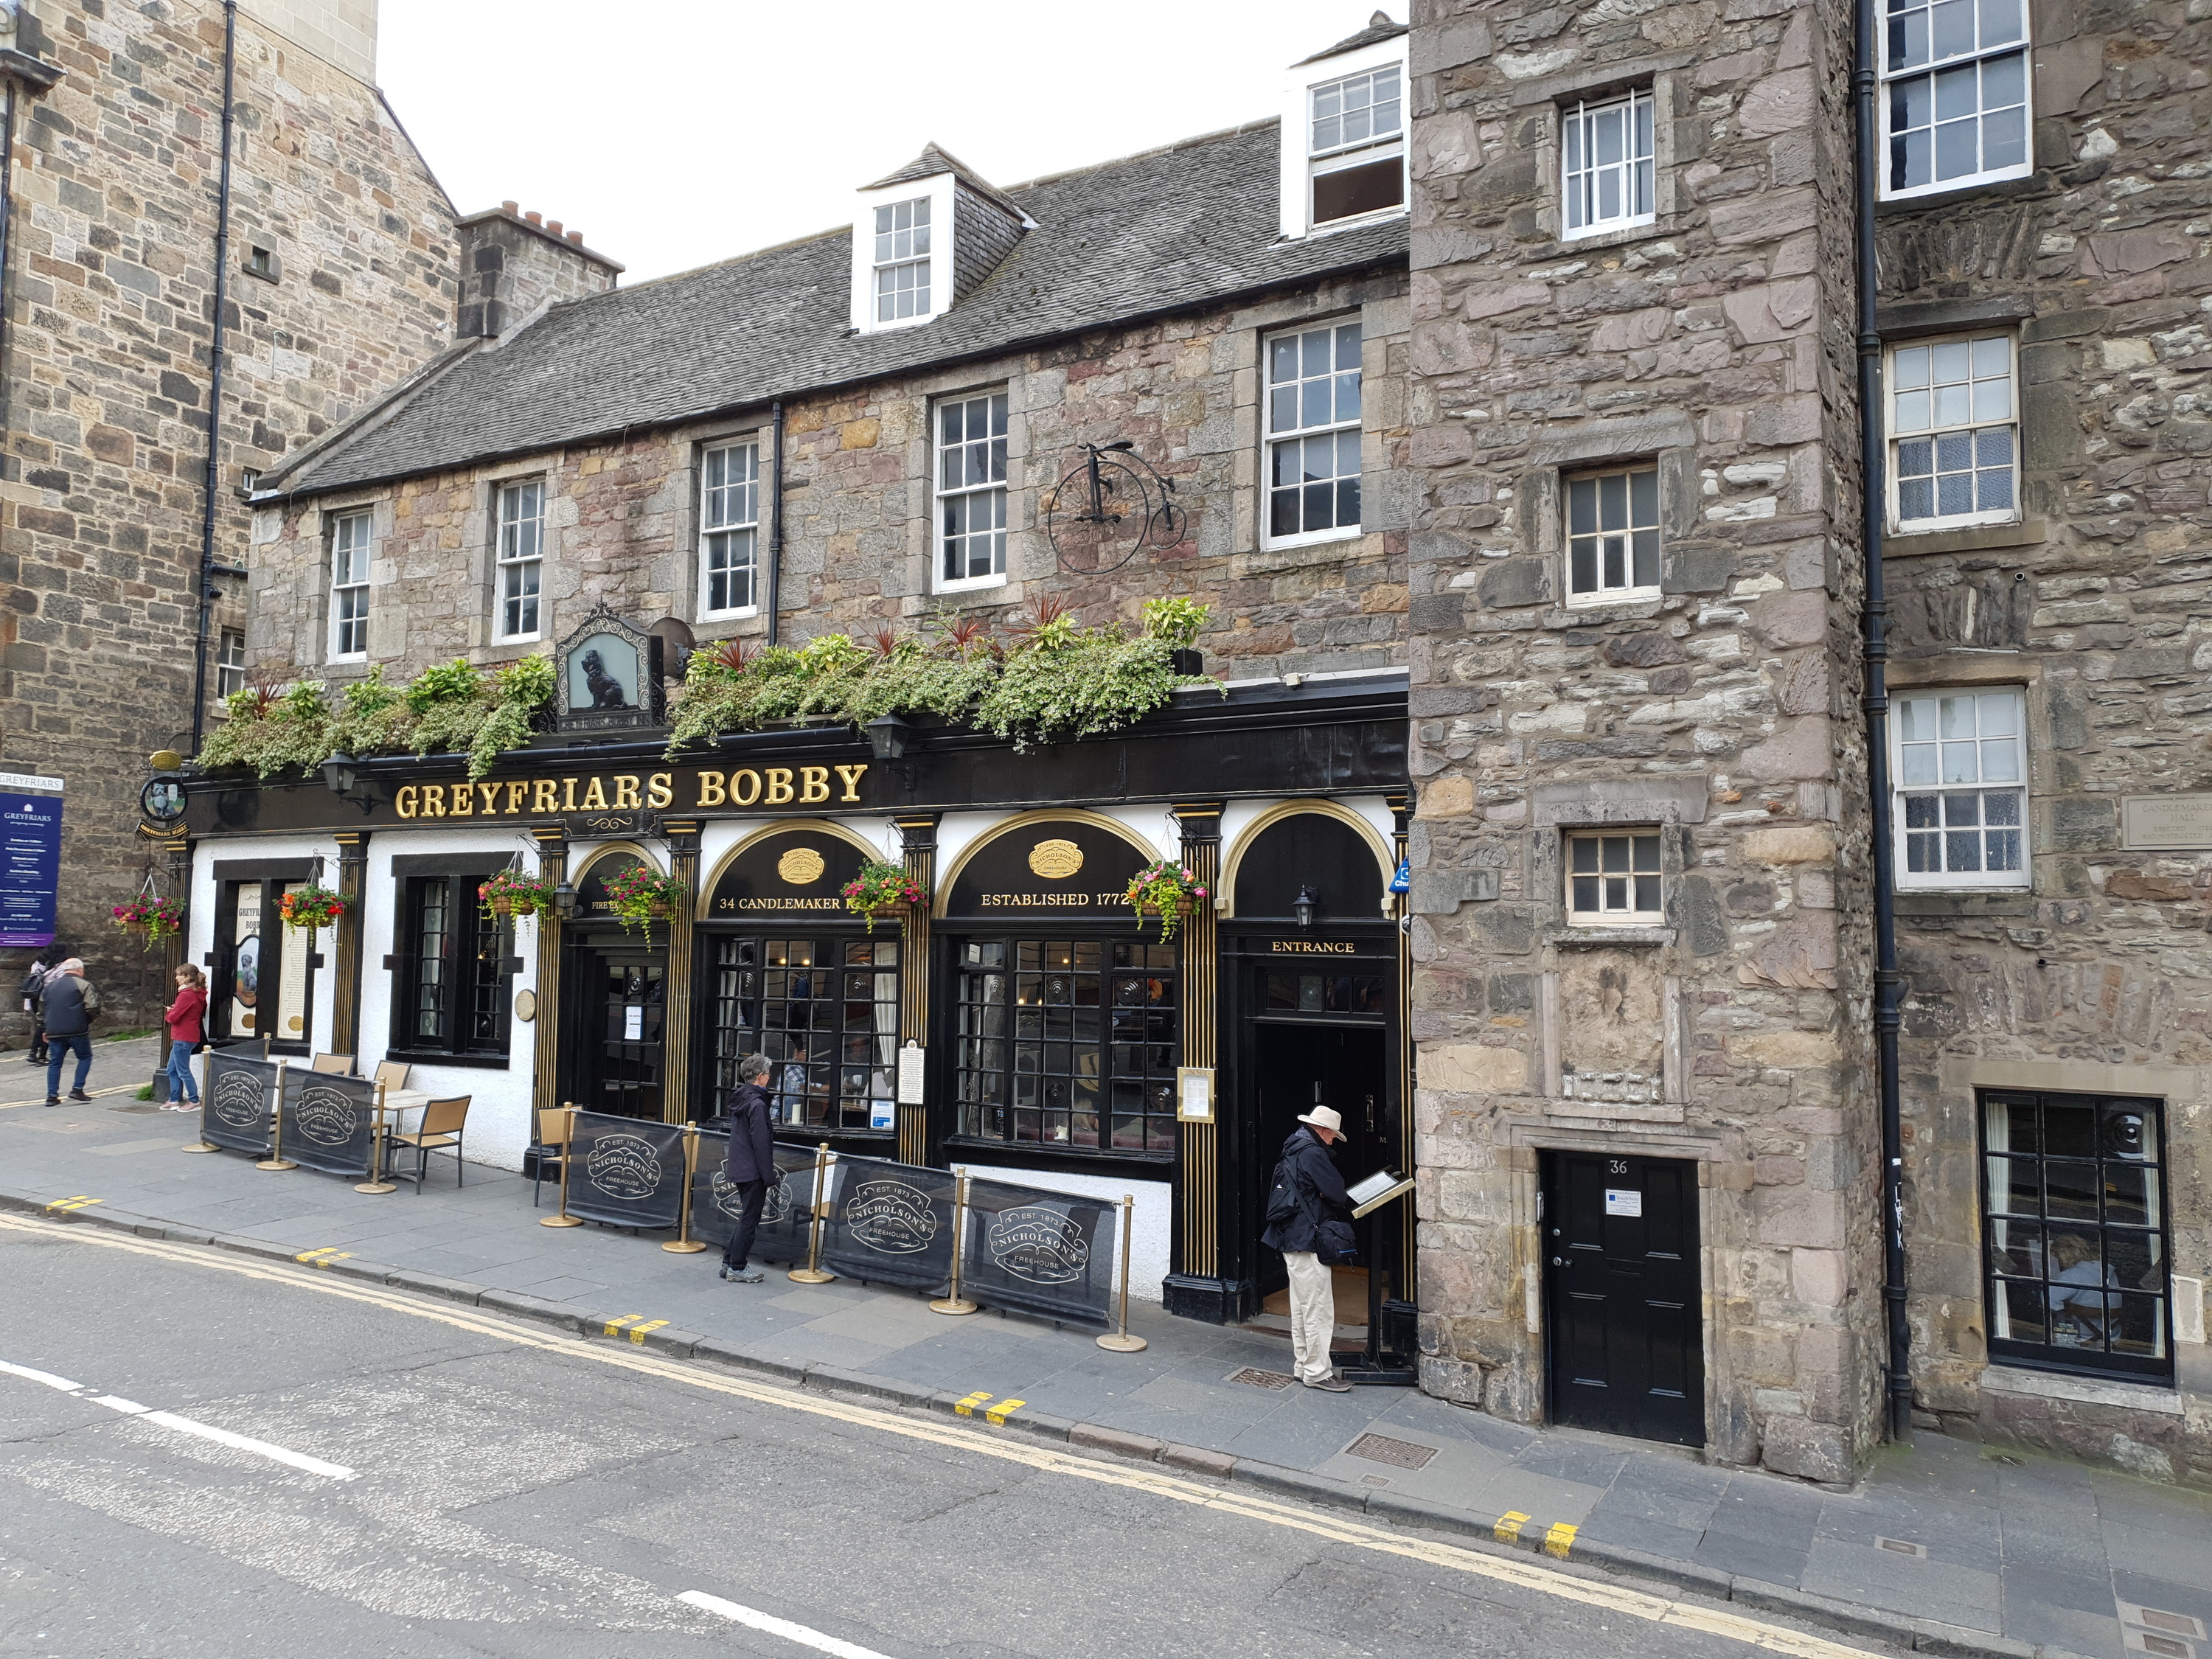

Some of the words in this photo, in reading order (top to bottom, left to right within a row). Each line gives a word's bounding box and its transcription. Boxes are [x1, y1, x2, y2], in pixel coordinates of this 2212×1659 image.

[0, 775, 59, 788] GREYFRIARS
[395, 773, 673, 818] GREYFRIARS
[697, 765, 868, 806] BOBBY
[4, 812, 52, 822] GREYFRIARS
[2171, 813, 2197, 821] HALL
[1035, 853, 1076, 865] NICHOLSON'S
[784, 860, 818, 871] NICHOLSON'S
[720, 898, 735, 909] 34
[739, 898, 841, 909] CANDLEMAKER
[981, 894, 1089, 905] ESTABLISHED
[1096, 893, 1130, 905] 1772
[591, 901, 608, 910] FIRE
[239, 908, 260, 917] GREYFR
[1272, 942, 1355, 953] ENTRANCE
[219, 1090, 258, 1109] NICHOLSON'S
[327, 1093, 338, 1102] 1873
[301, 1107, 349, 1128] NICHOLSON'S
[310, 1124, 338, 1134] FREEHOUSE
[627, 1141, 640, 1150] 1873
[594, 1157, 653, 1180] NICHOLSON'S
[1610, 1160, 1627, 1174] 36
[605, 1176, 639, 1186] FREEHOUSE
[894, 1188, 910, 1198] 1873
[855, 1206, 927, 1232] NICHOLSON'S
[1040, 1214, 1059, 1225] 1873
[869, 1227, 910, 1239] FREEHOUSE
[998, 1233, 1078, 1262] NICHOLSON'S
[1015, 1256, 1059, 1269] FREEHOUSE
